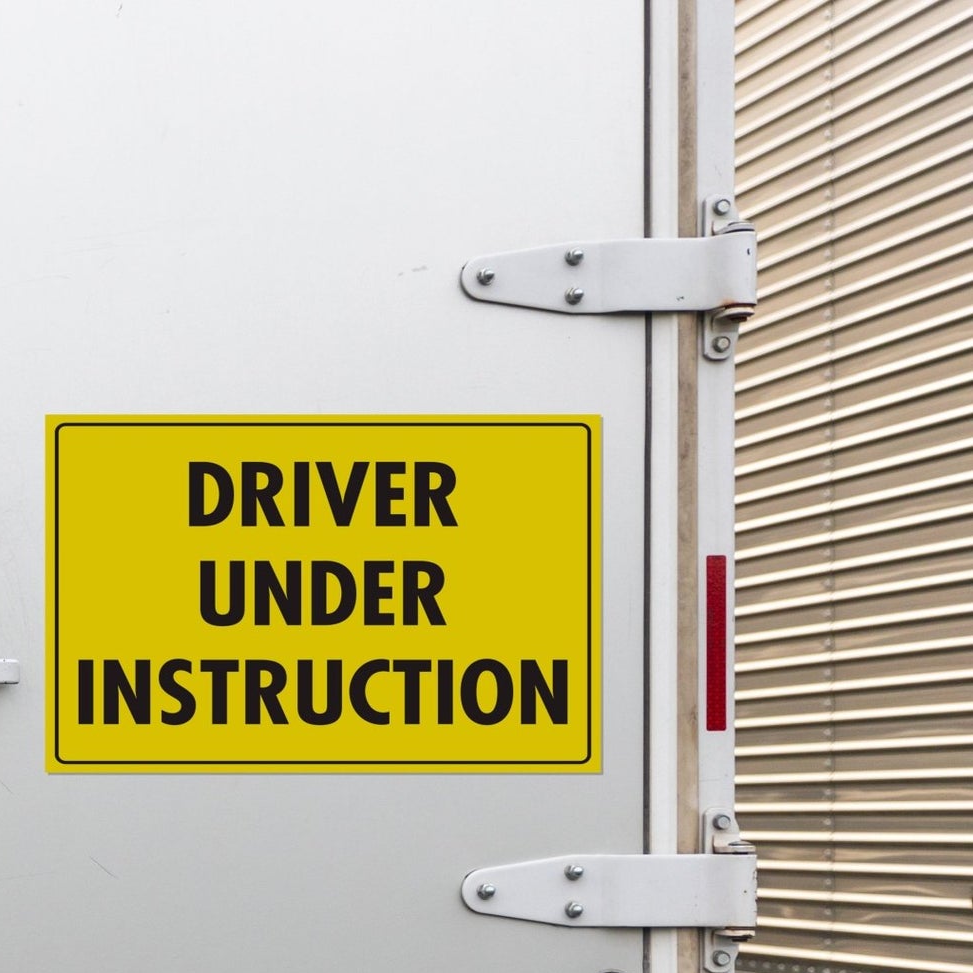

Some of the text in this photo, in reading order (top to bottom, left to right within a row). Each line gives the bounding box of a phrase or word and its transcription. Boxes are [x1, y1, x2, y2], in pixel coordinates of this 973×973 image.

[189, 461, 458, 527] DRIVER
[200, 560, 447, 627] UNDER
[79, 658, 568, 726] INSTRUCTION
